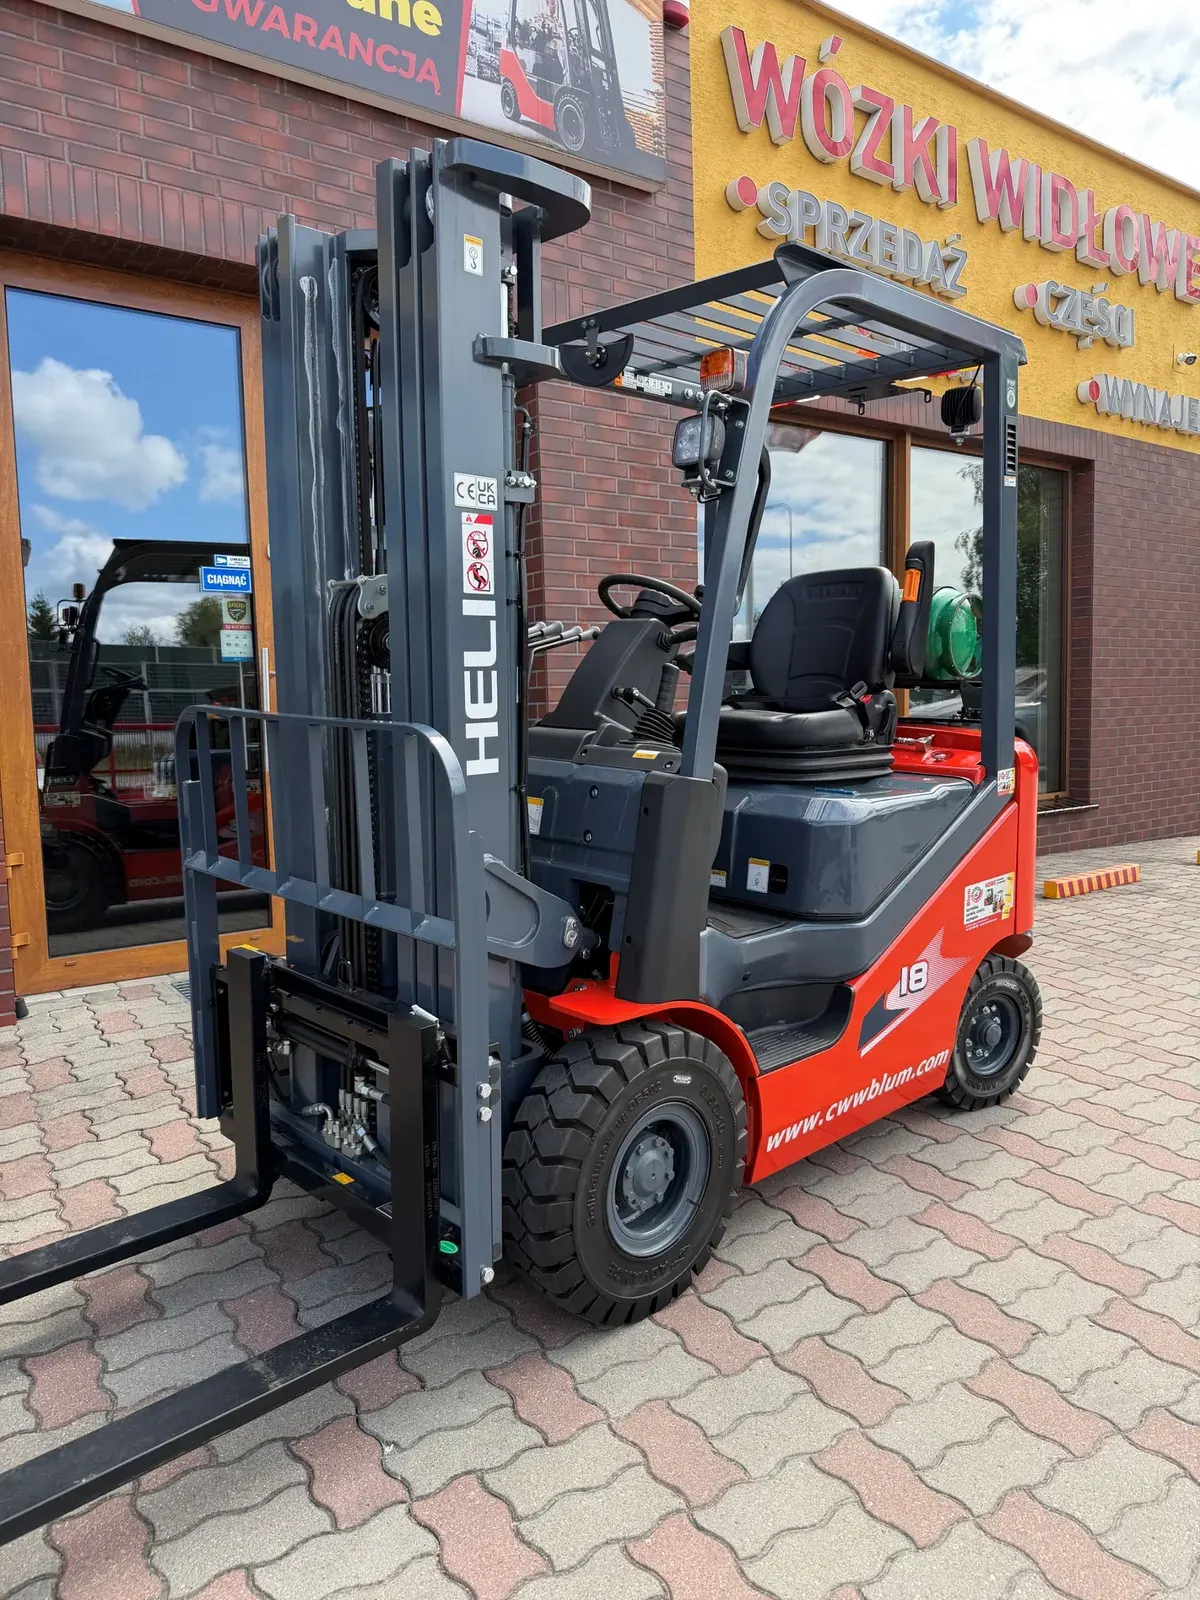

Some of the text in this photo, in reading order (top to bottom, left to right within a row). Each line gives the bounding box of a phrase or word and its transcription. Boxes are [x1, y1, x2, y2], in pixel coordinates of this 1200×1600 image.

[720, 25, 958, 208] WÓZKI
[757, 181, 968, 299] SPRZEDAŻ
[1034, 280, 1135, 350] CZĘŚCI
[457, 481, 495, 500] CE UK
[478, 494, 496, 505] CA
[207, 573, 247, 587] CIĄGNĄĆ
[462, 599, 499, 776] HELI
[899, 960, 929, 998] 18
[766, 1049, 949, 1152] www.cwwblum.com
